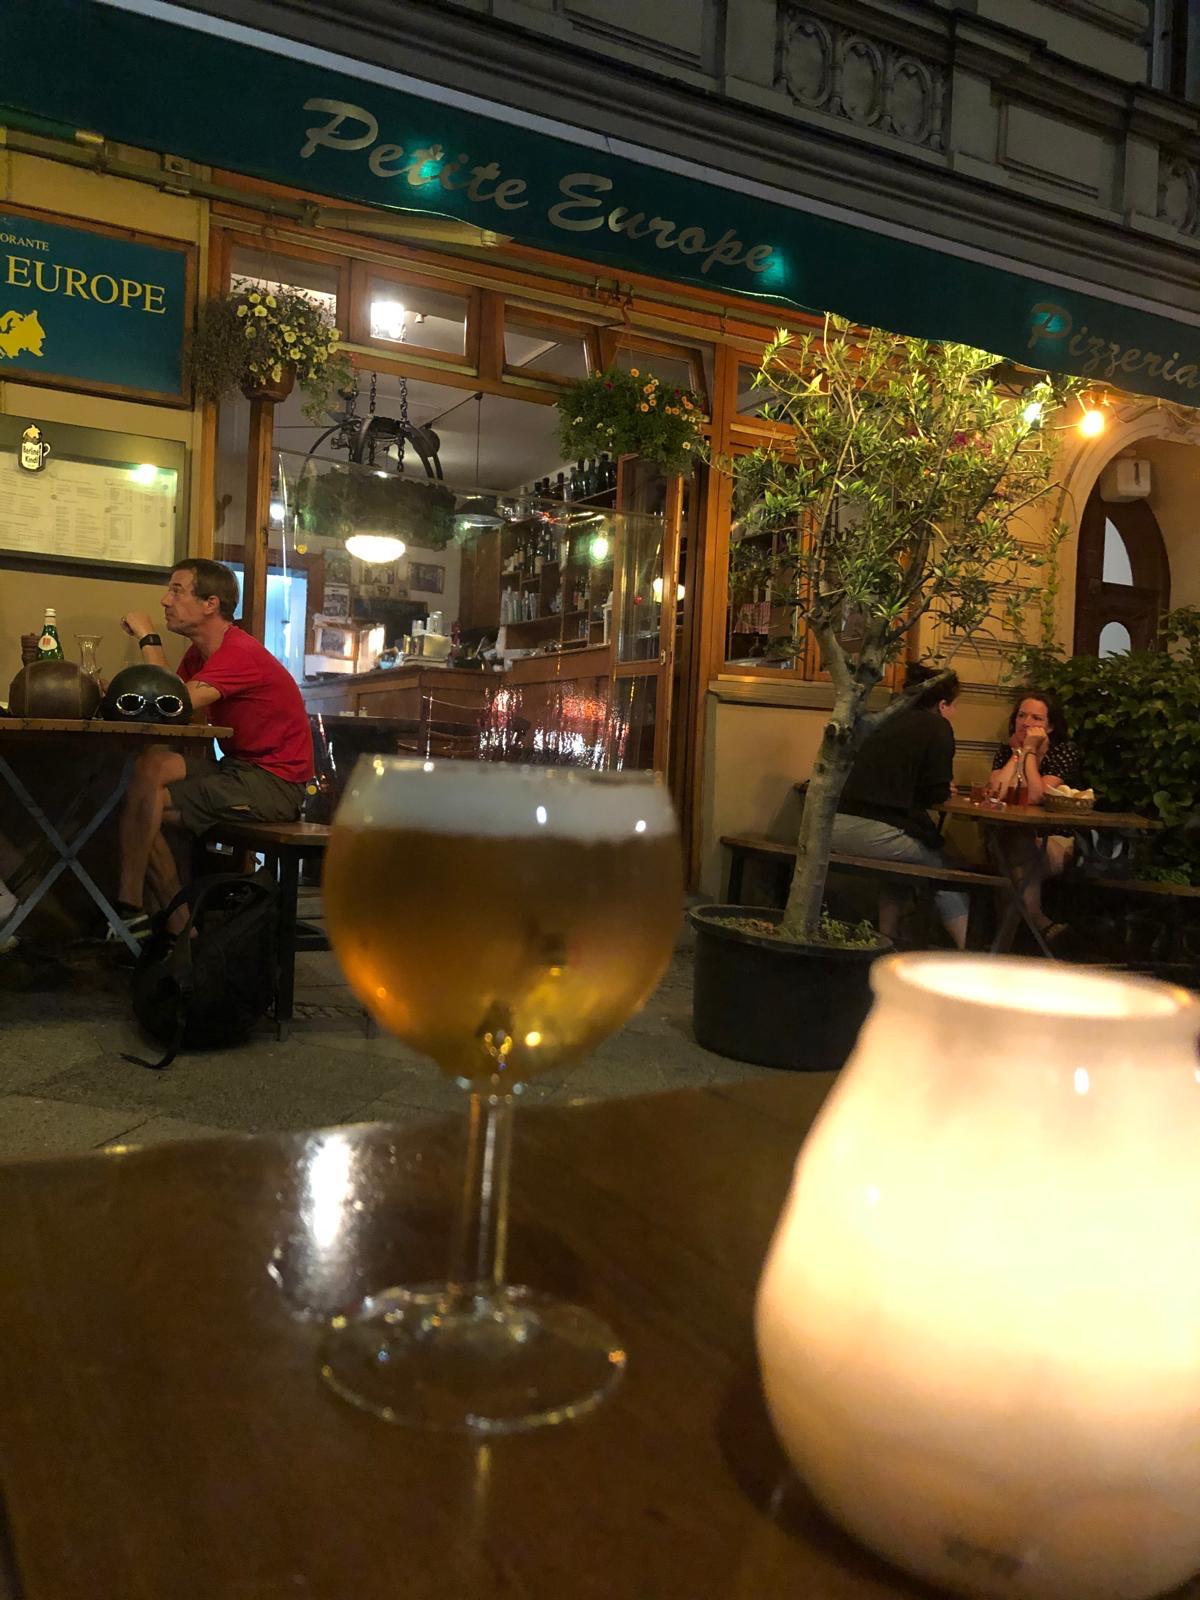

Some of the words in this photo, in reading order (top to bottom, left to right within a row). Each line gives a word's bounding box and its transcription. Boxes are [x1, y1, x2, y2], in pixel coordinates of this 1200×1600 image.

[301, 97, 528, 210] Petite
[547, 172, 775, 274] Europe
[0, 233, 49, 251] ORANTE
[6, 255, 166, 314] EUROPE
[1027, 303, 1200, 389] Pizzeria
